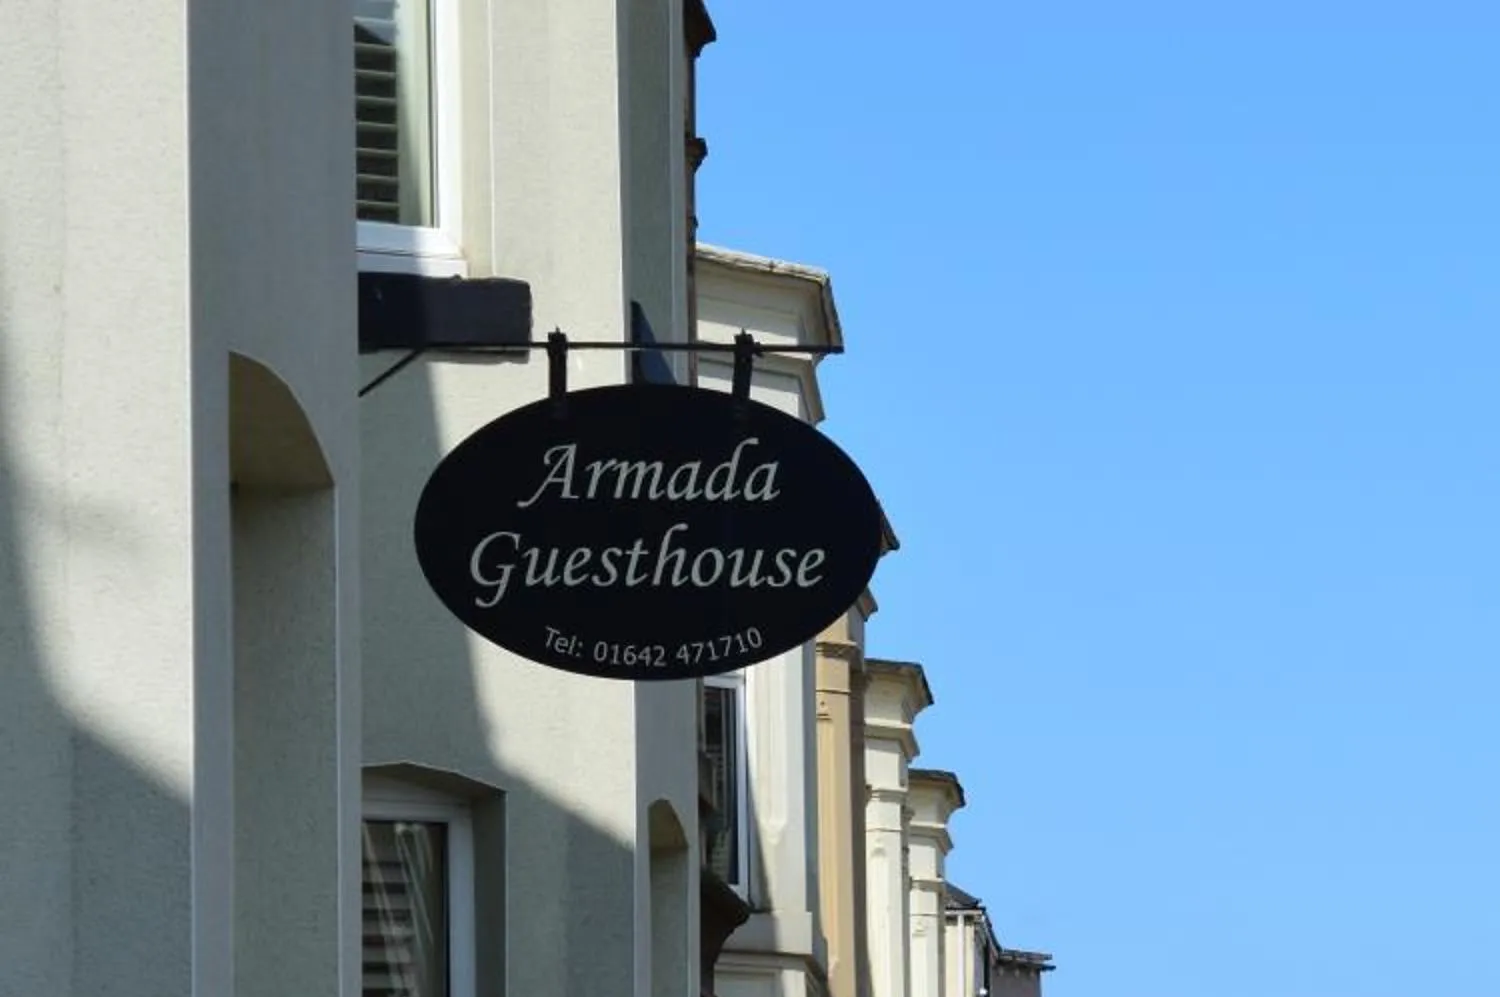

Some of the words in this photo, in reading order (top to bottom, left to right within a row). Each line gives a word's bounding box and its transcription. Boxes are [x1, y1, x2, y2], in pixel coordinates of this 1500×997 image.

[517, 437, 781, 508] Armada
[469, 523, 826, 608] Guesthouse
[545, 625, 583, 657] Tel:
[593, 641, 667, 667] 01642
[676, 626, 763, 665] 471710
